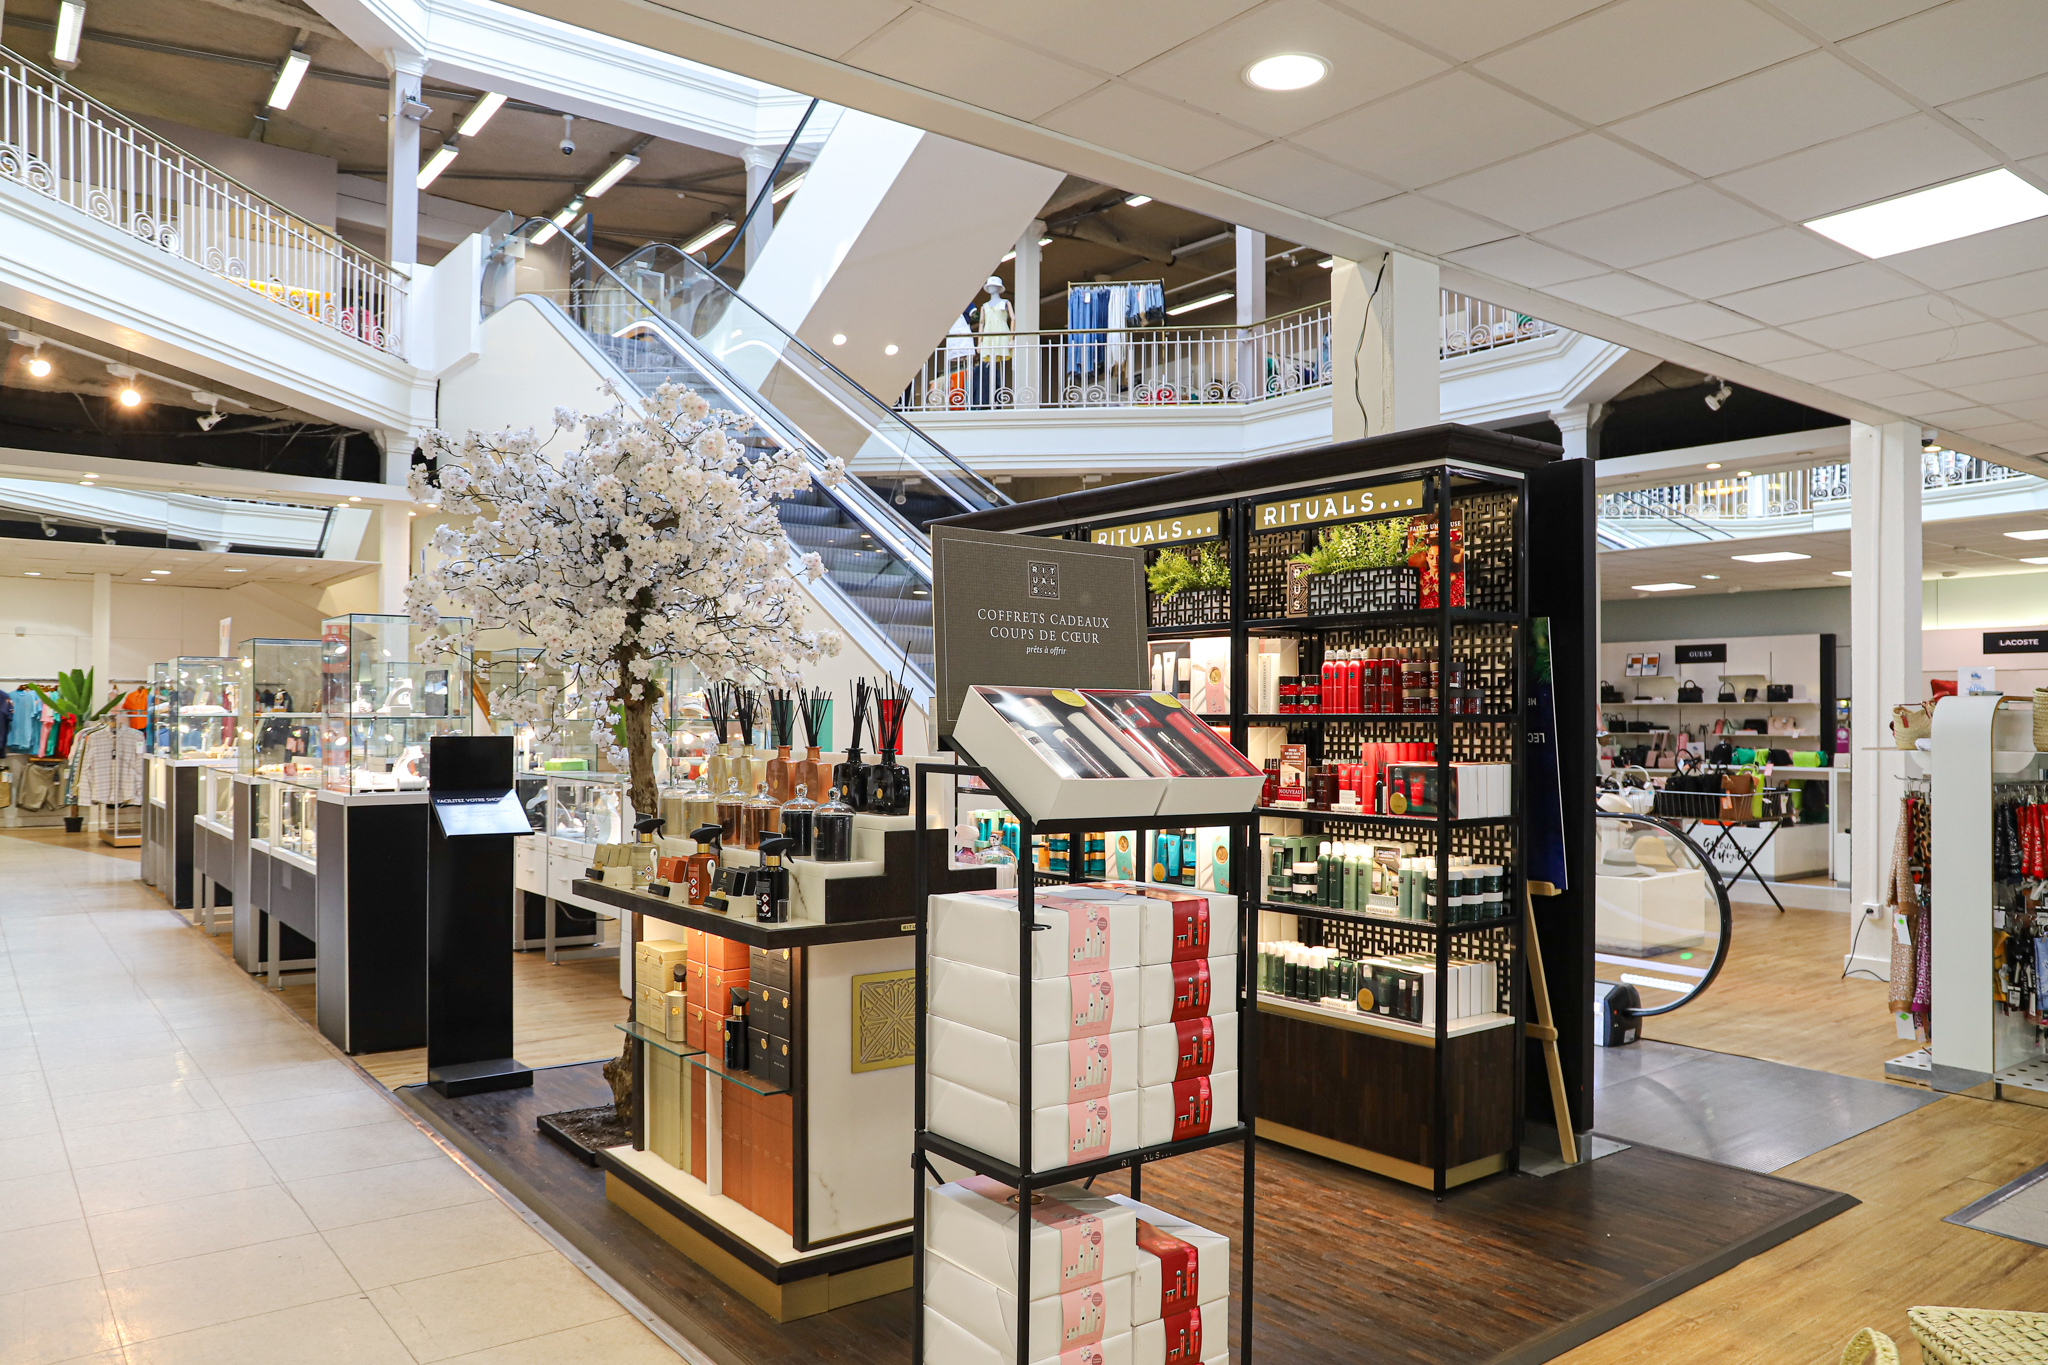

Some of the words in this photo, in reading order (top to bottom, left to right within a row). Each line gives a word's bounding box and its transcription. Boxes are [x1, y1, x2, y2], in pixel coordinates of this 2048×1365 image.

[1264, 492, 1414, 527] RITUALS...
[977, 608, 1045, 624] COFFRETS
[1050, 613, 1110, 629] CADEAUX
[990, 626, 1034, 641] COUPS
[1039, 629, 1057, 641] DE
[1061, 631, 1100, 644] CŒUR
[1999, 638, 2039, 646] LACOSTE
[1026, 644, 1043, 655] prêts
[1044, 645, 1049, 654] à
[1050, 646, 1067, 656] offrir
[1689, 650, 1713, 658] GUESS
[1370, 898, 1395, 906] NOUVEAU
